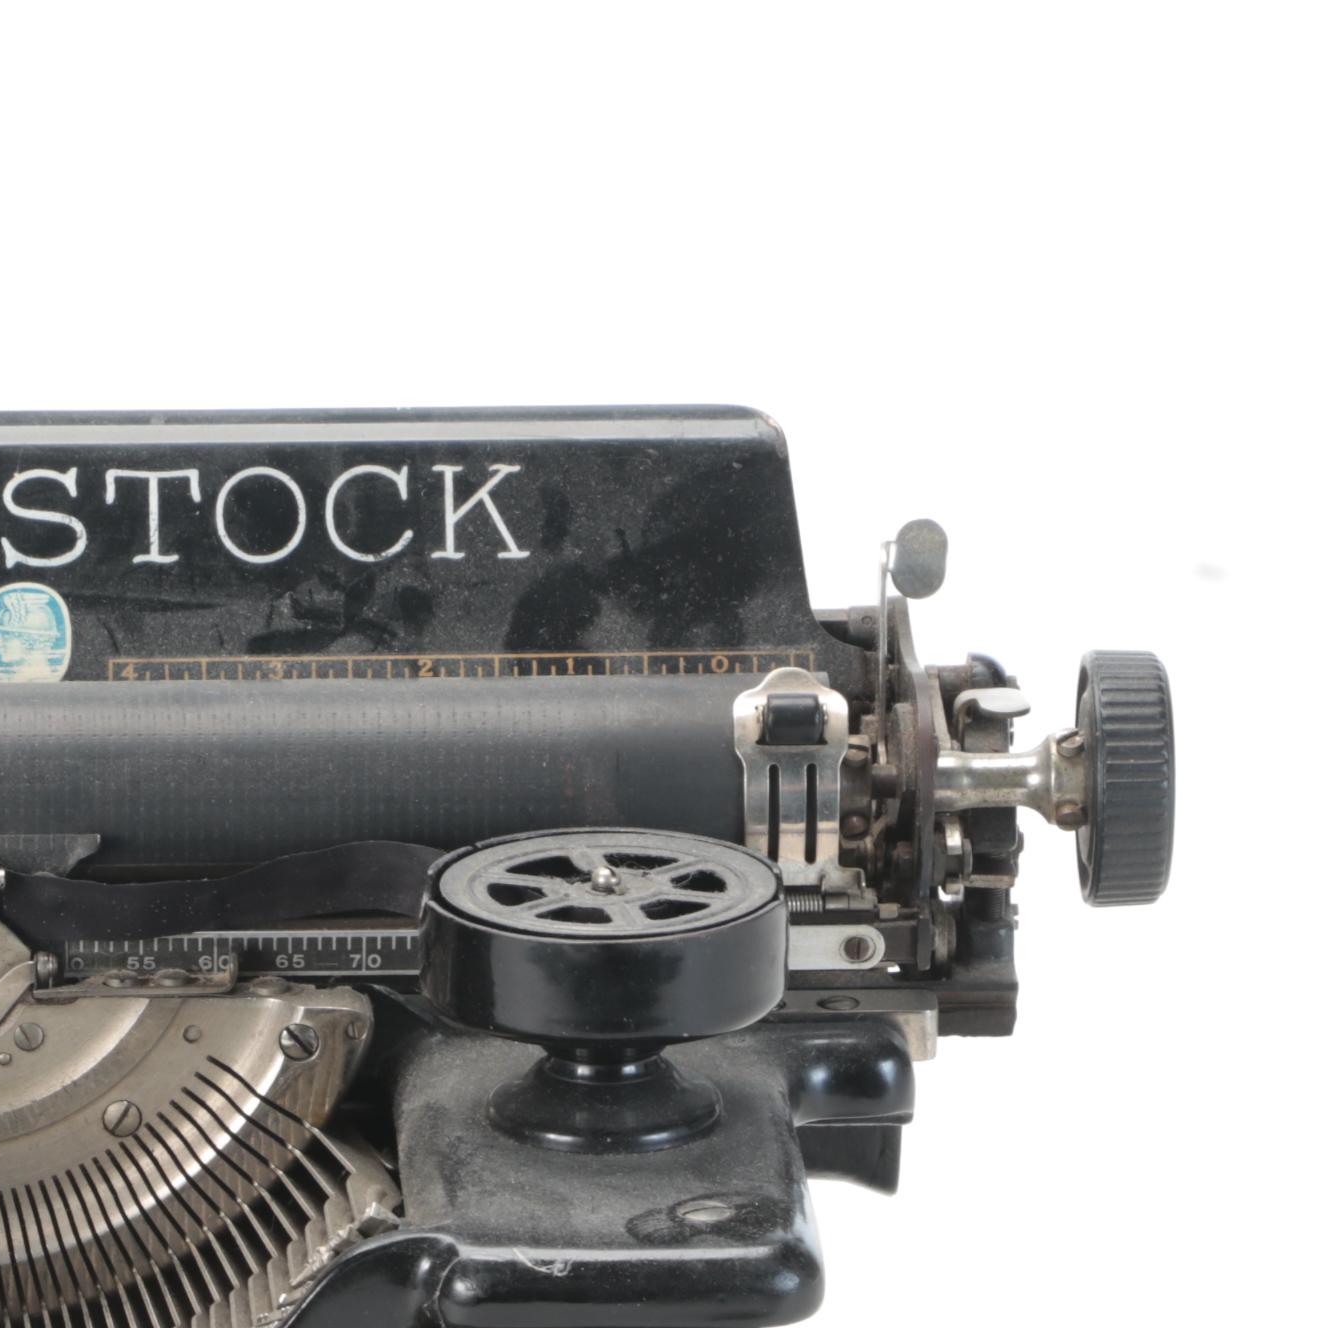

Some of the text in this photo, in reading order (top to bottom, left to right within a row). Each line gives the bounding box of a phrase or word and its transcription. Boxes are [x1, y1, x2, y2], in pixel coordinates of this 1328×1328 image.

[122, 661, 138, 680] 4
[268, 661, 284, 679] 3
[418, 659, 433, 677] 2
[127, 956, 157, 970] 55
[198, 954, 234, 970] 60
[275, 954, 305, 969] 65
[349, 953, 382, 969] 70
